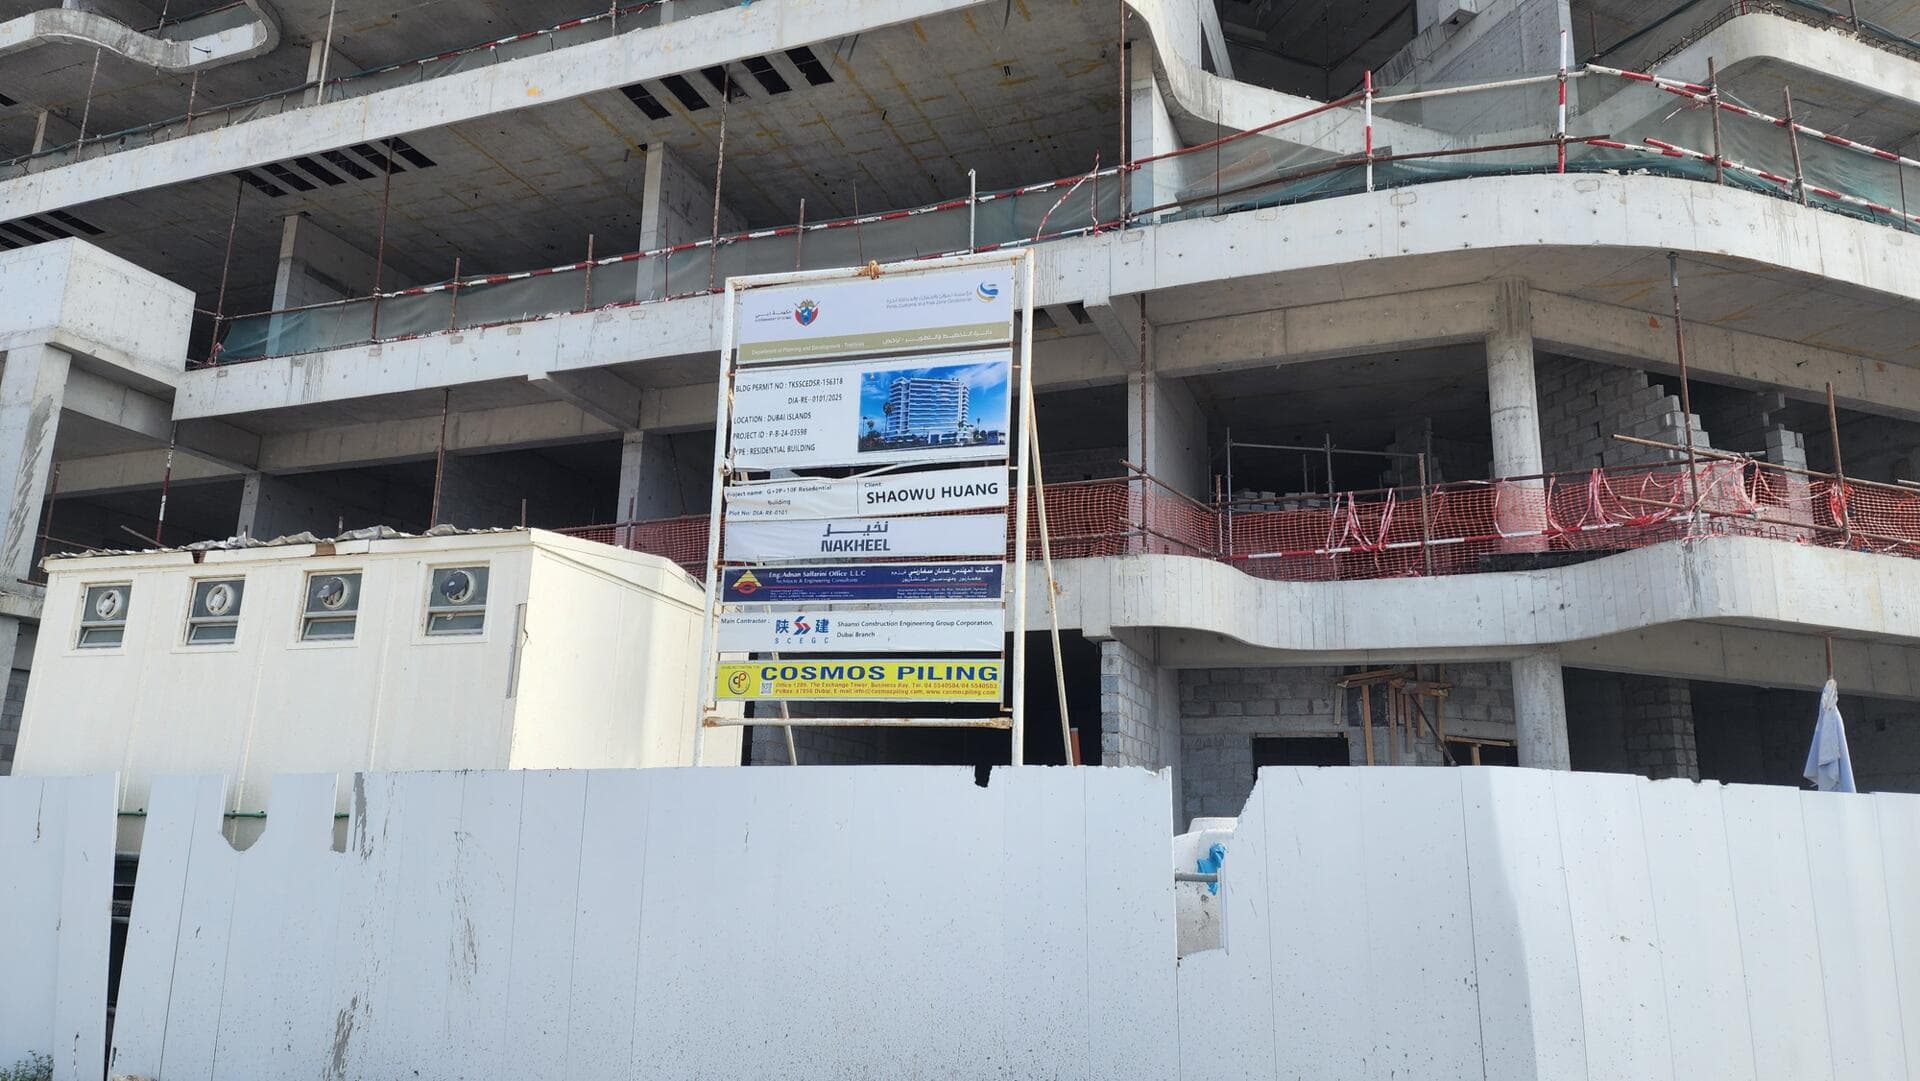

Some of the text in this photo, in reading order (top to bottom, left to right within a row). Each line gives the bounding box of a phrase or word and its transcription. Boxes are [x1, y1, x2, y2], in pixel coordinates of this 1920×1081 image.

[735, 384, 751, 393] BLDG
[752, 382, 773, 391] PERMIT
[774, 381, 784, 390] NO
[733, 415, 763, 425] LOCATION
[767, 412, 786, 422] DUBAI
[787, 411, 812, 421] ISLANDS
[732, 431, 757, 441] PROJECT
[758, 430, 765, 438] ID
[750, 444, 786, 455] RESIDENTIAL
[787, 443, 816, 453] BUILDING
[866, 482, 999, 504] SHAOWU HUANG
[821, 538, 891, 553] NAKHEEL
[782, 570, 801, 578] Adnan
[828, 568, 848, 577] Office
[775, 619, 829, 634] 陕 建
[899, 619, 934, 628] Engineering
[935, 619, 955, 628] Group
[855, 630, 876, 638] Branch
[761, 666, 998, 681] COSMOS PILING
